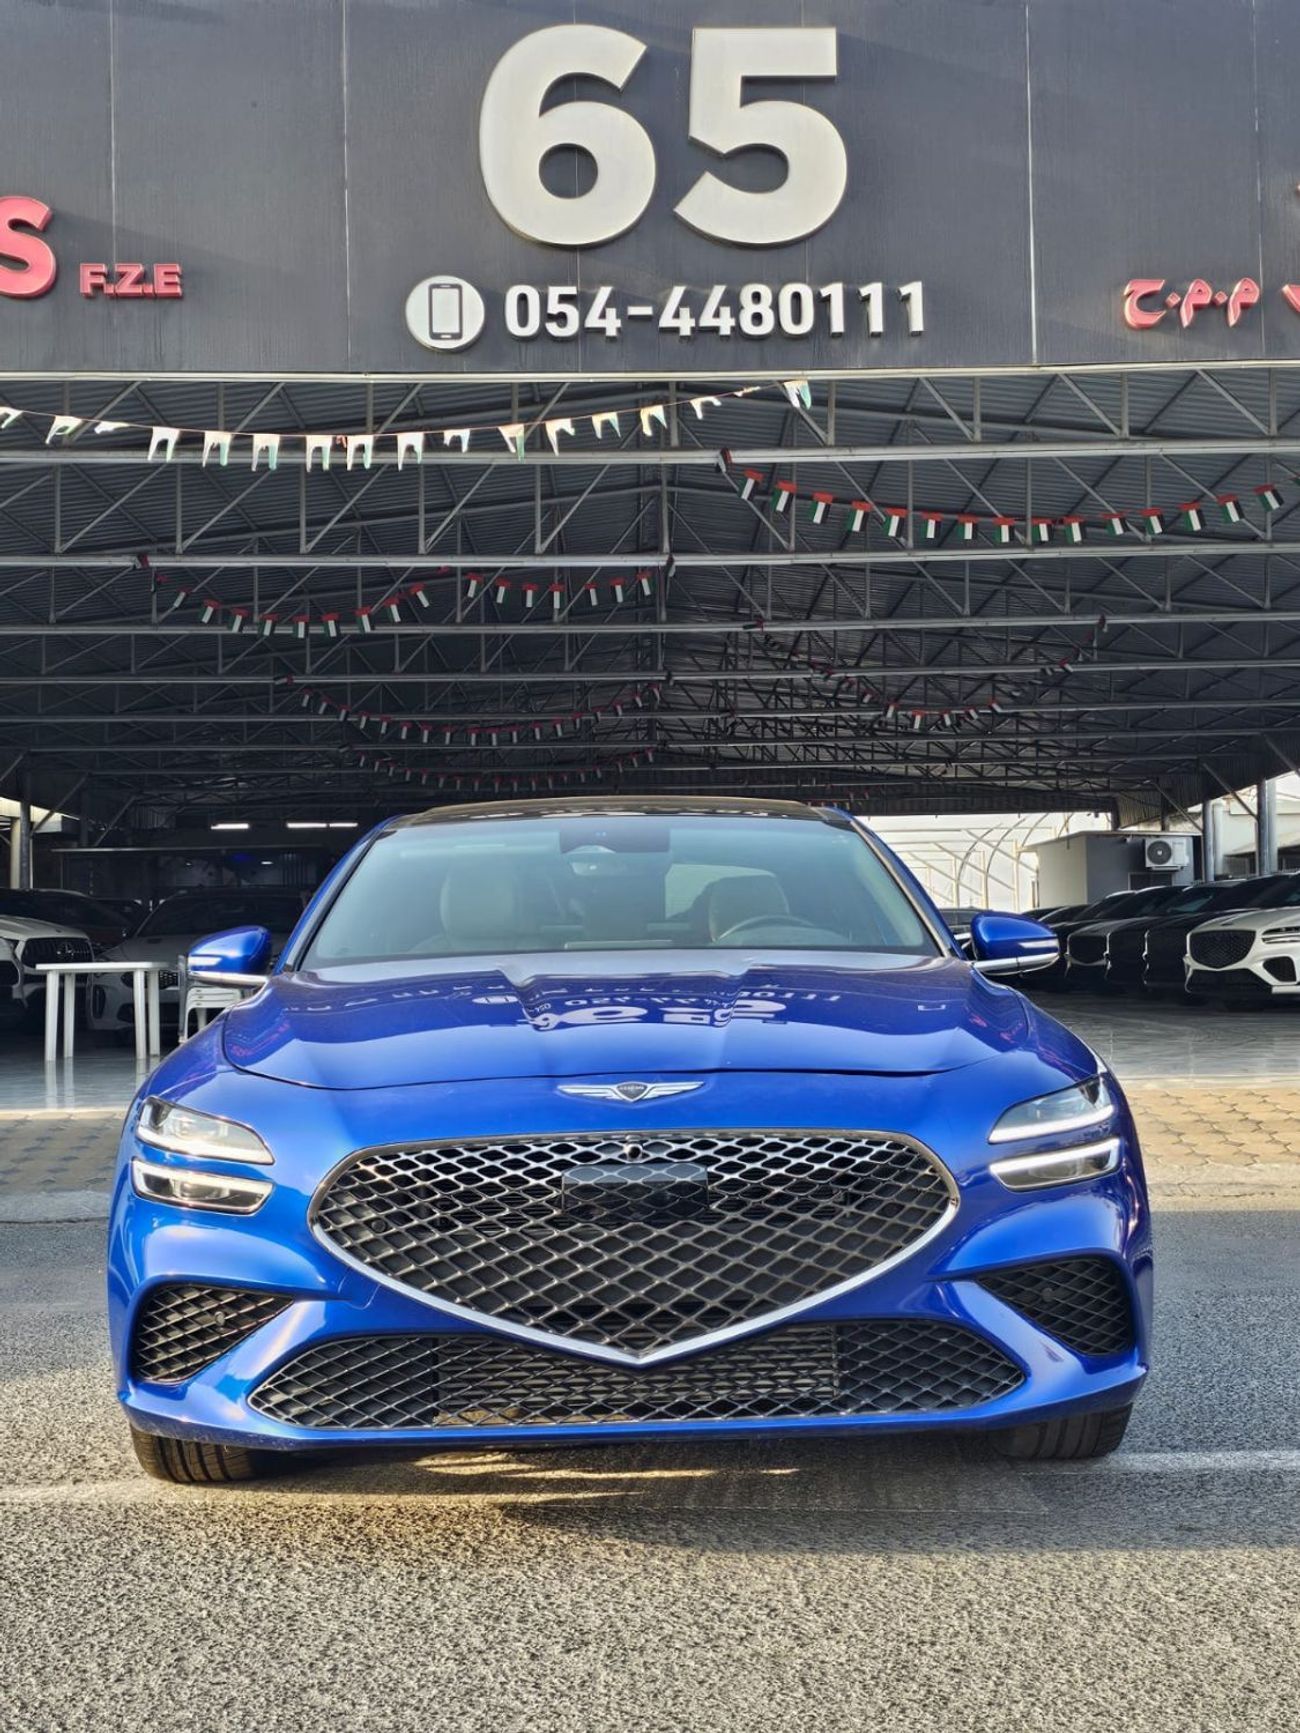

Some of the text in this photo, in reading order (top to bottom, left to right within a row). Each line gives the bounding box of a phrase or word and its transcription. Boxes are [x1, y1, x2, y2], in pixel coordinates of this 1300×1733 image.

[479, 25, 849, 247] 65
[79, 263, 184, 299] F.Z.E
[504, 281, 926, 340] 054-4480111
